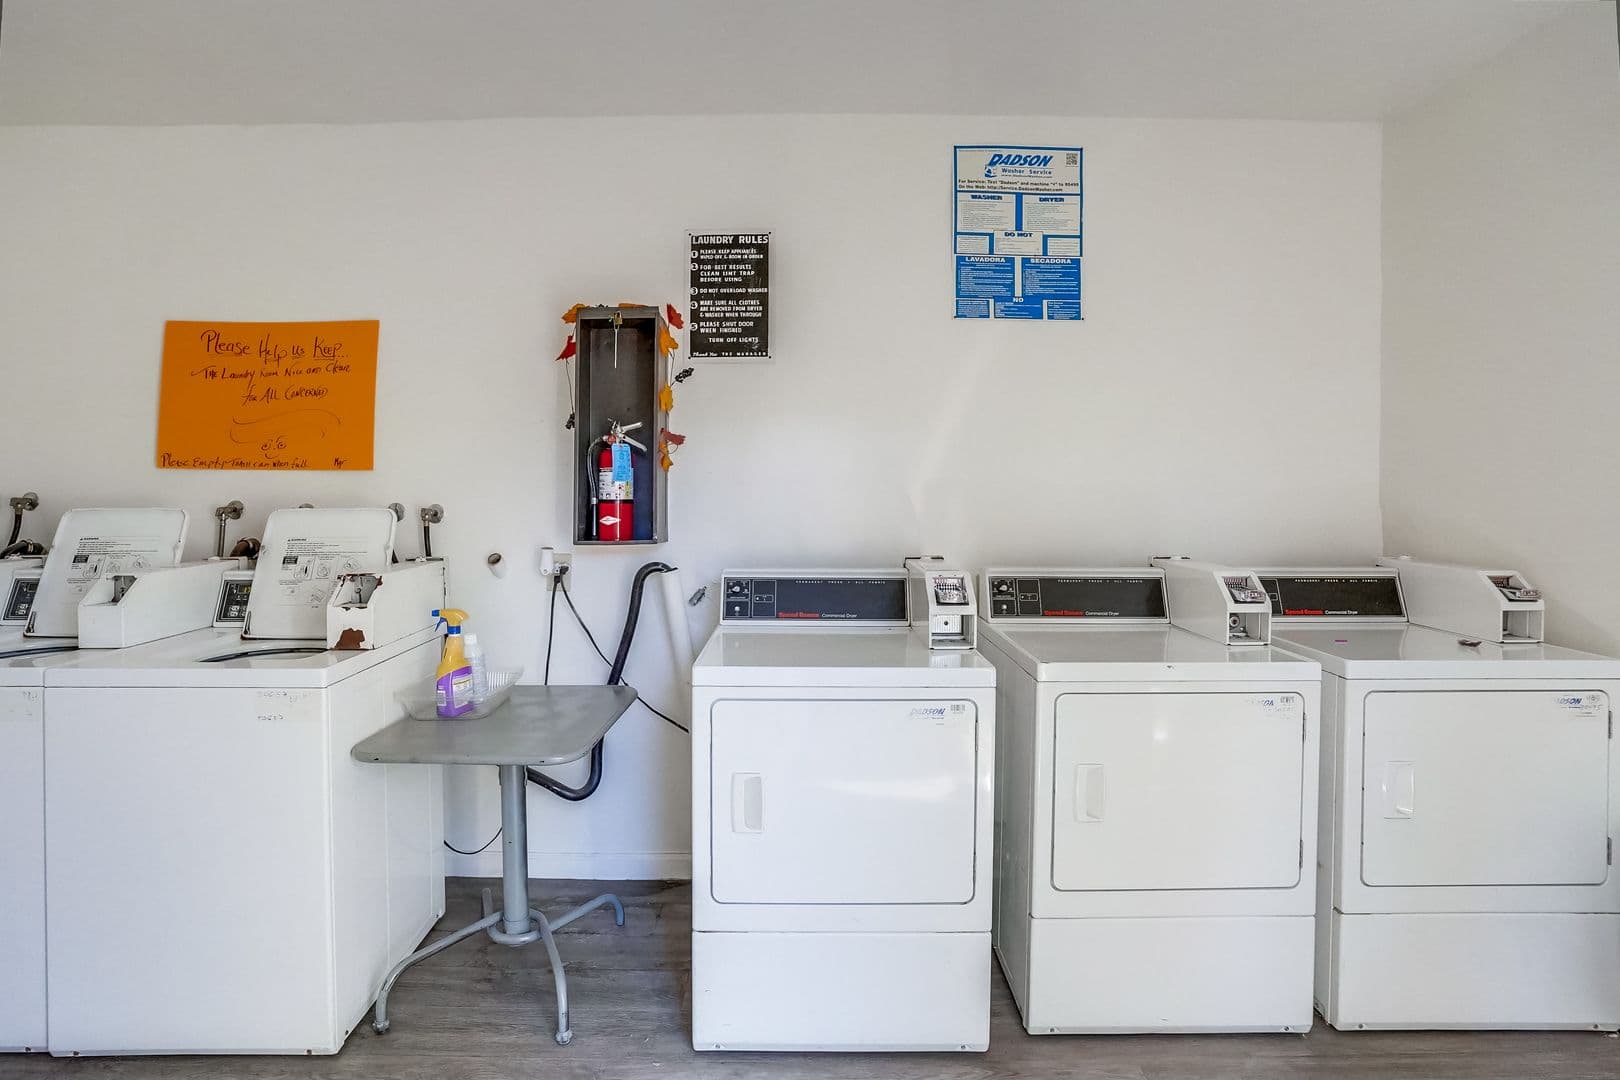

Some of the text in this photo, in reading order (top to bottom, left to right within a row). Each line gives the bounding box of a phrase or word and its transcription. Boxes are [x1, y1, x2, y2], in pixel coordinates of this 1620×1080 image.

[988, 154, 1053, 166] DADSON
[692, 235, 769, 244] LAUNDRY RULES
[201, 330, 250, 355] Please
[259, 332, 287, 367] Help
[292, 344, 305, 356] Us
[161, 452, 189, 468] Please
